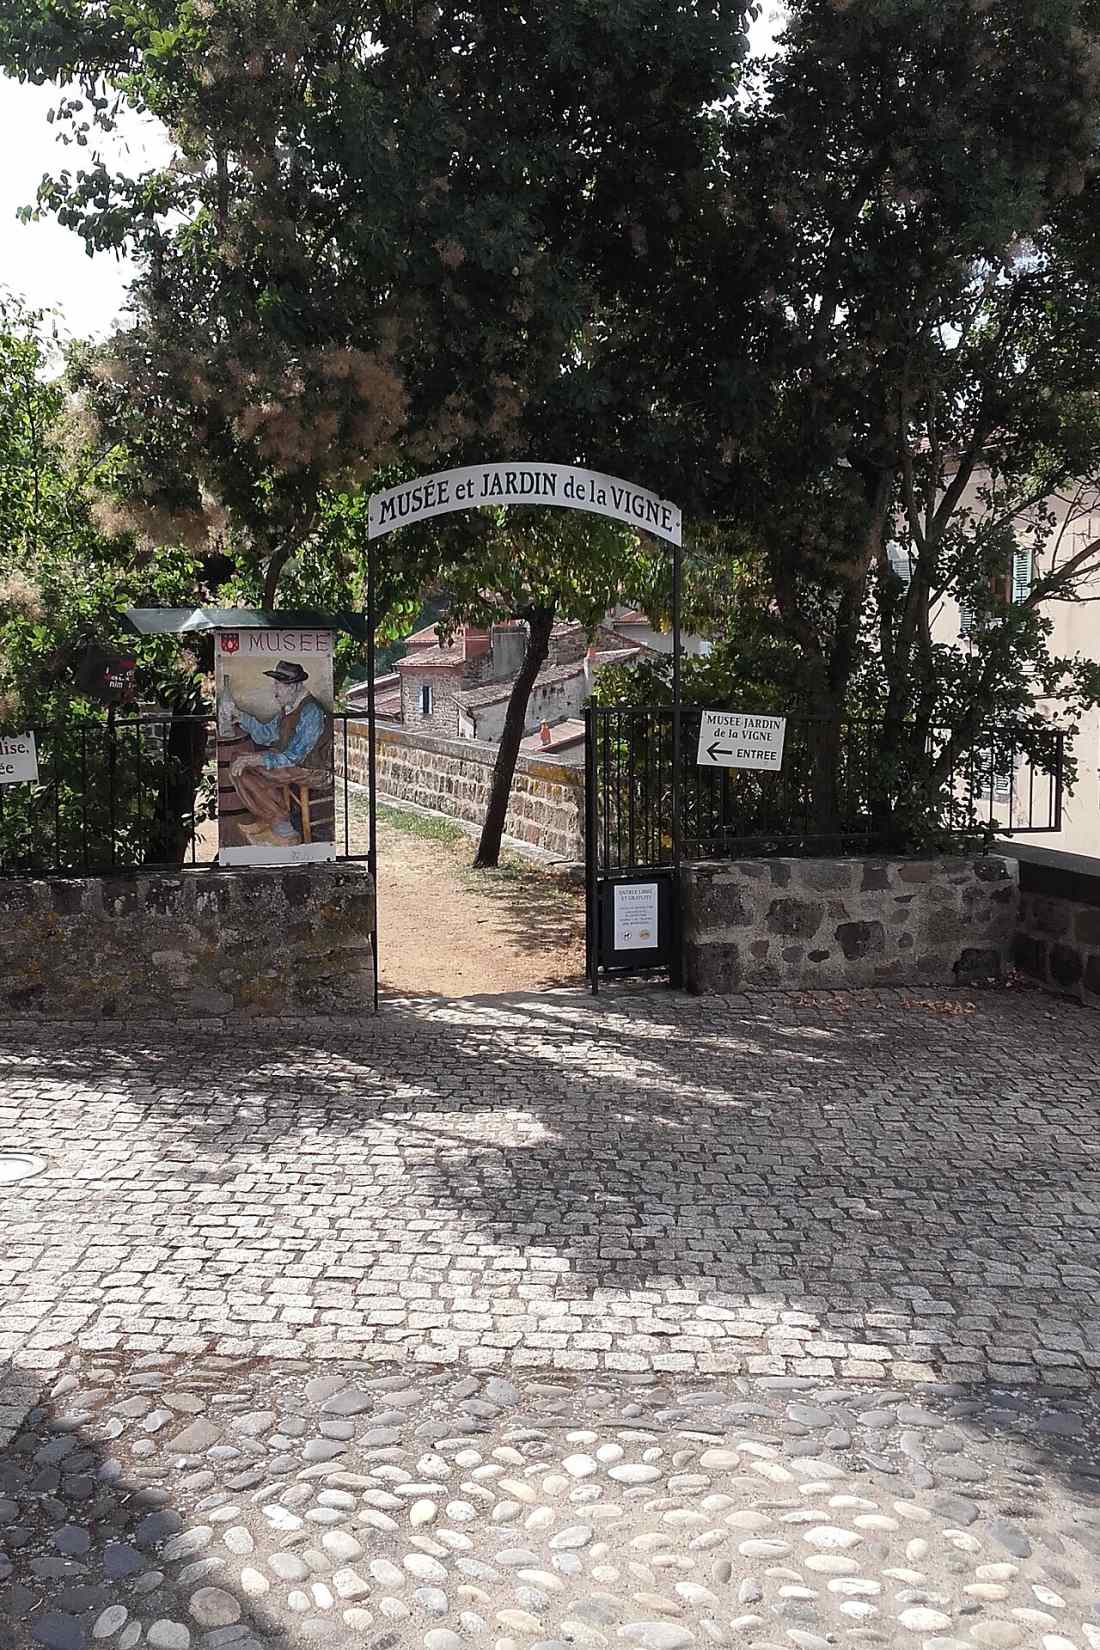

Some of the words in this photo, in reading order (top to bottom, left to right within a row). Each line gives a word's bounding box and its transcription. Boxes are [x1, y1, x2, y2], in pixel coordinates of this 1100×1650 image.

[379, 480, 449, 524] MUSÉE
[455, 478, 475, 499] et
[480, 472, 557, 498] JARDIN
[564, 475, 585, 500] de
[589, 479, 608, 506] la
[611, 485, 673, 532] VIGNE
[249, 632, 330, 651] MUSEE
[744, 718, 781, 729] JARDIN
[713, 728, 726, 738] de
[728, 729, 738, 739] la
[742, 730, 773, 741] VIGNE
[737, 749, 777, 761] ENTREE
